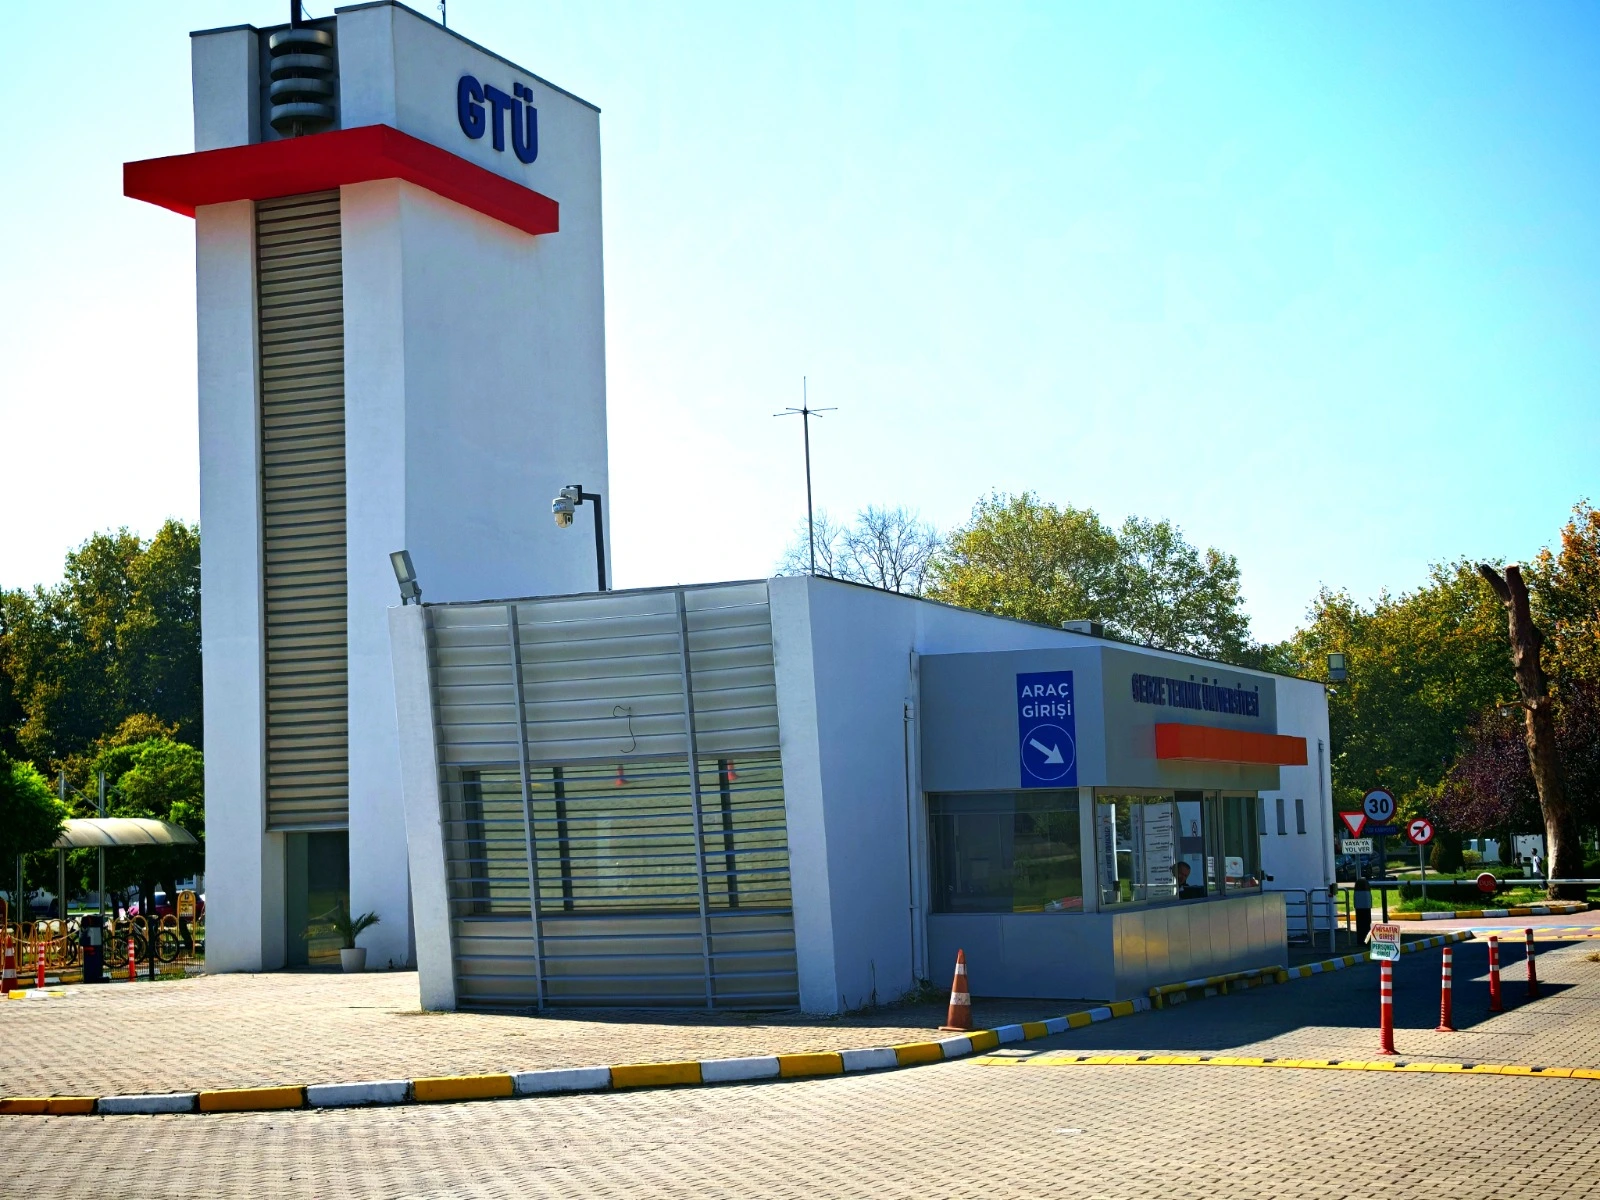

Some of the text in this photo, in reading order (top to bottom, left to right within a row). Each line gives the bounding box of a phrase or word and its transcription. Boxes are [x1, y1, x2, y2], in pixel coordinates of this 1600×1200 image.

[457, 75, 539, 164] GTÜ
[1021, 683, 1069, 698] ARAÇ
[1022, 700, 1071, 719] GİRİŞİ
[1369, 799, 1389, 814] 30
